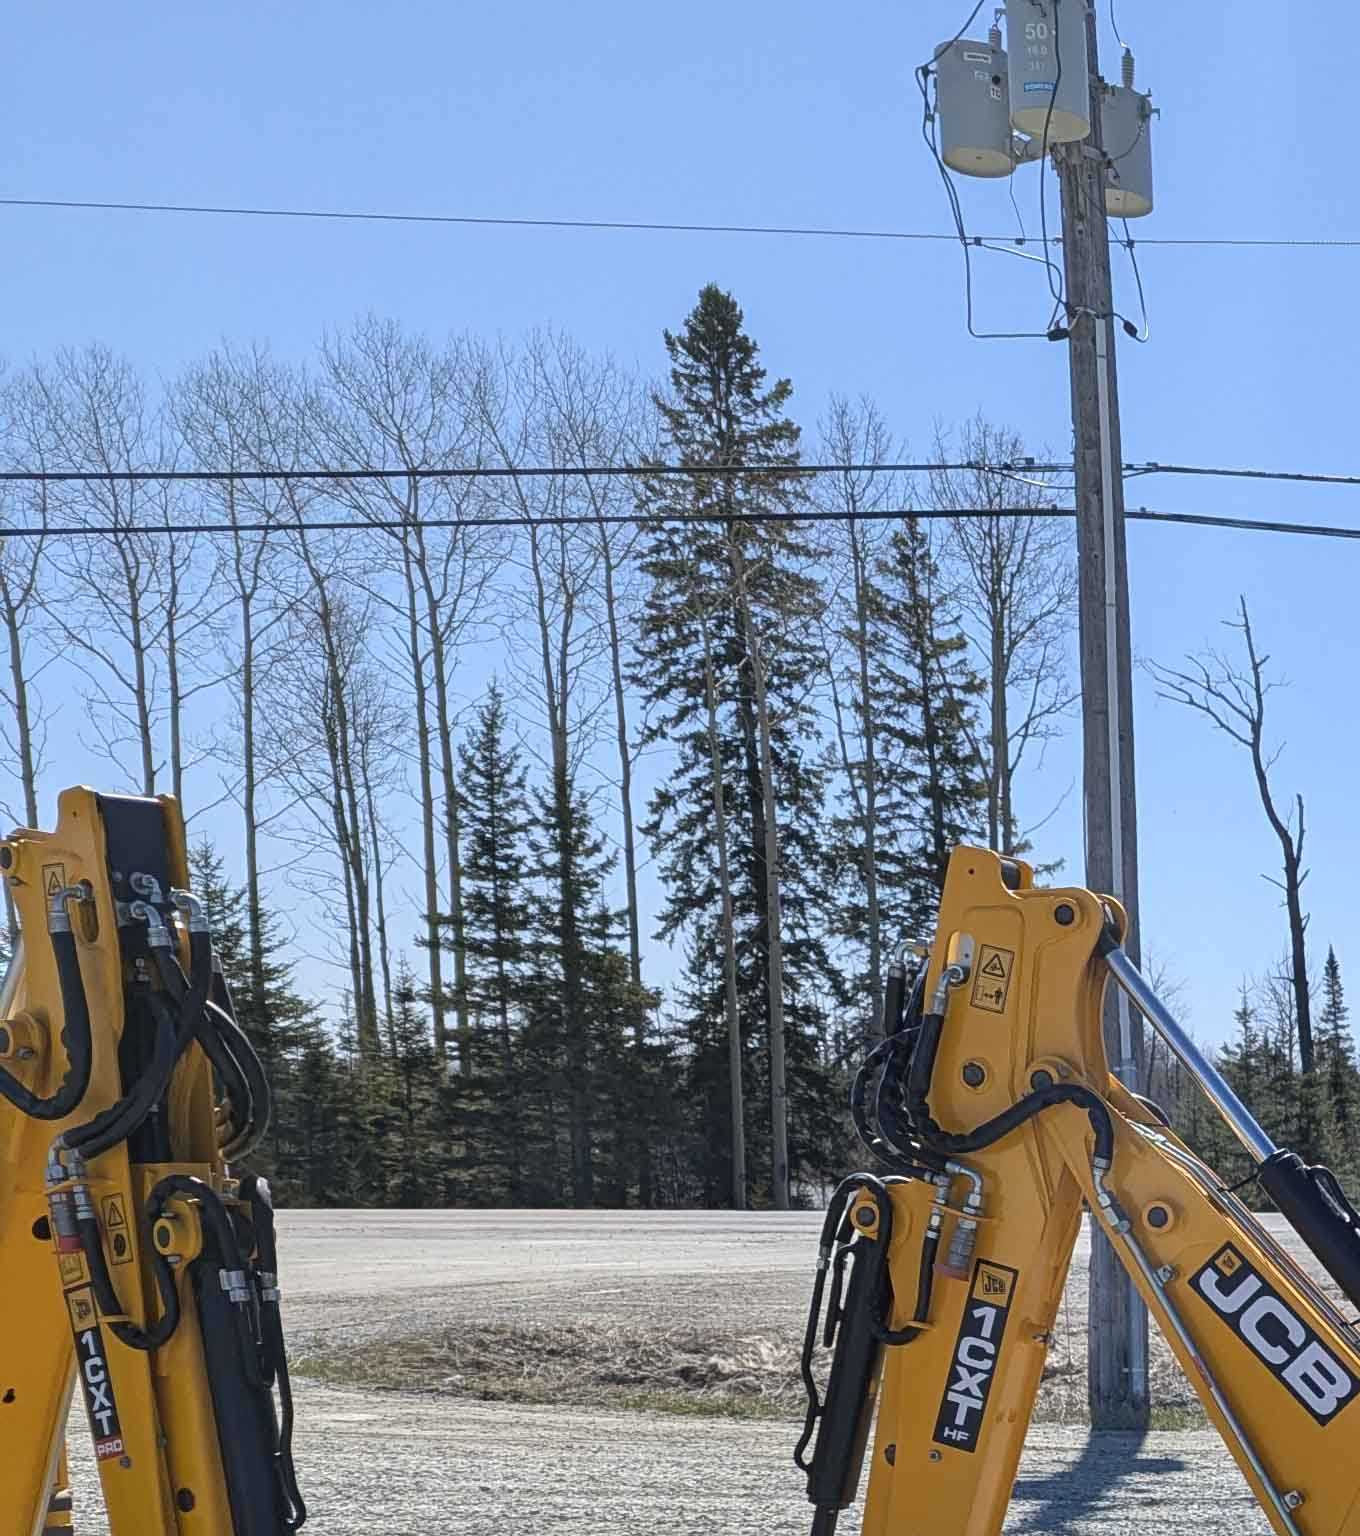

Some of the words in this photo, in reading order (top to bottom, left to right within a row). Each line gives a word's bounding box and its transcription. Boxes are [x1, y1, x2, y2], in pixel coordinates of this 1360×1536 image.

[1025, 23, 1047, 40] 50
[81, 1330, 112, 1436] 1CXT
[946, 1306, 997, 1426] 1CXT
[1199, 1266, 1352, 1416] JCB
[943, 1425, 971, 1442] HF
